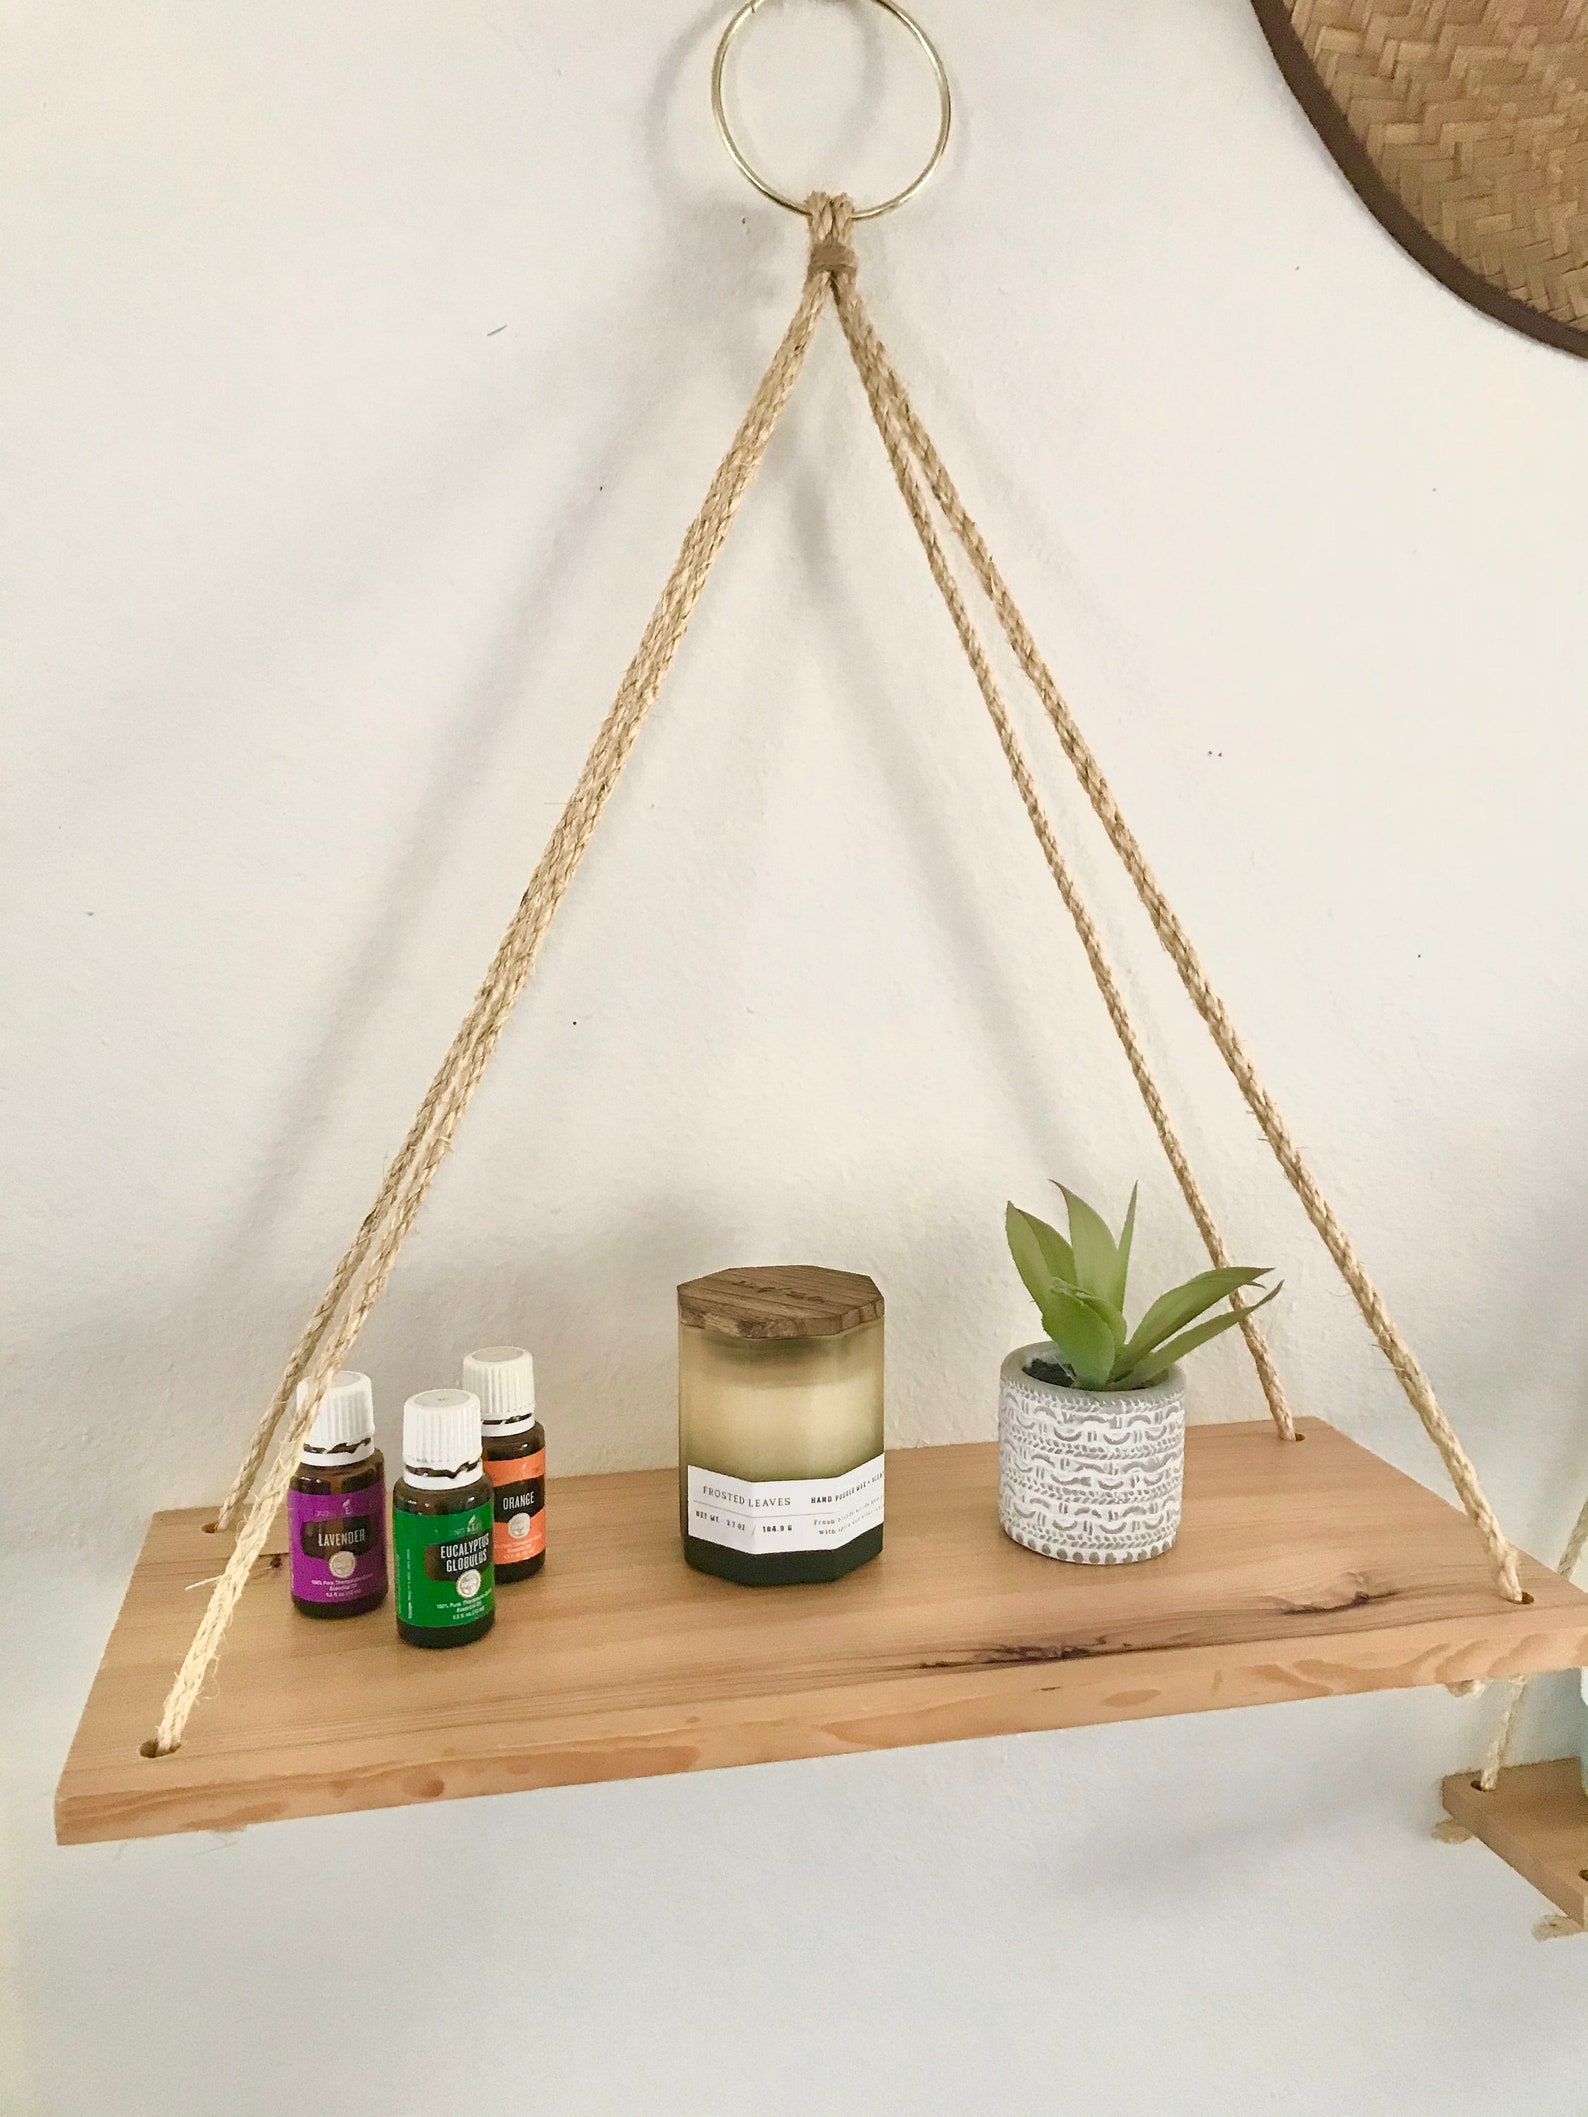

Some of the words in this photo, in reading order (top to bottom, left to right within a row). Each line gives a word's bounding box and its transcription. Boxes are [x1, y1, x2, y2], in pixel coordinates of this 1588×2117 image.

[502, 1491, 535, 1511] ORANGE
[703, 1486, 745, 1505] FROSTED
[748, 1497, 791, 1508] LEAVES
[810, 1495, 833, 1504] HAND
[695, 1510, 708, 1520] NET
[318, 1528, 365, 1547] LAVENDER
[440, 1532, 490, 1559] EUCALYPTUS
[446, 1549, 487, 1573] GLOBULUS
